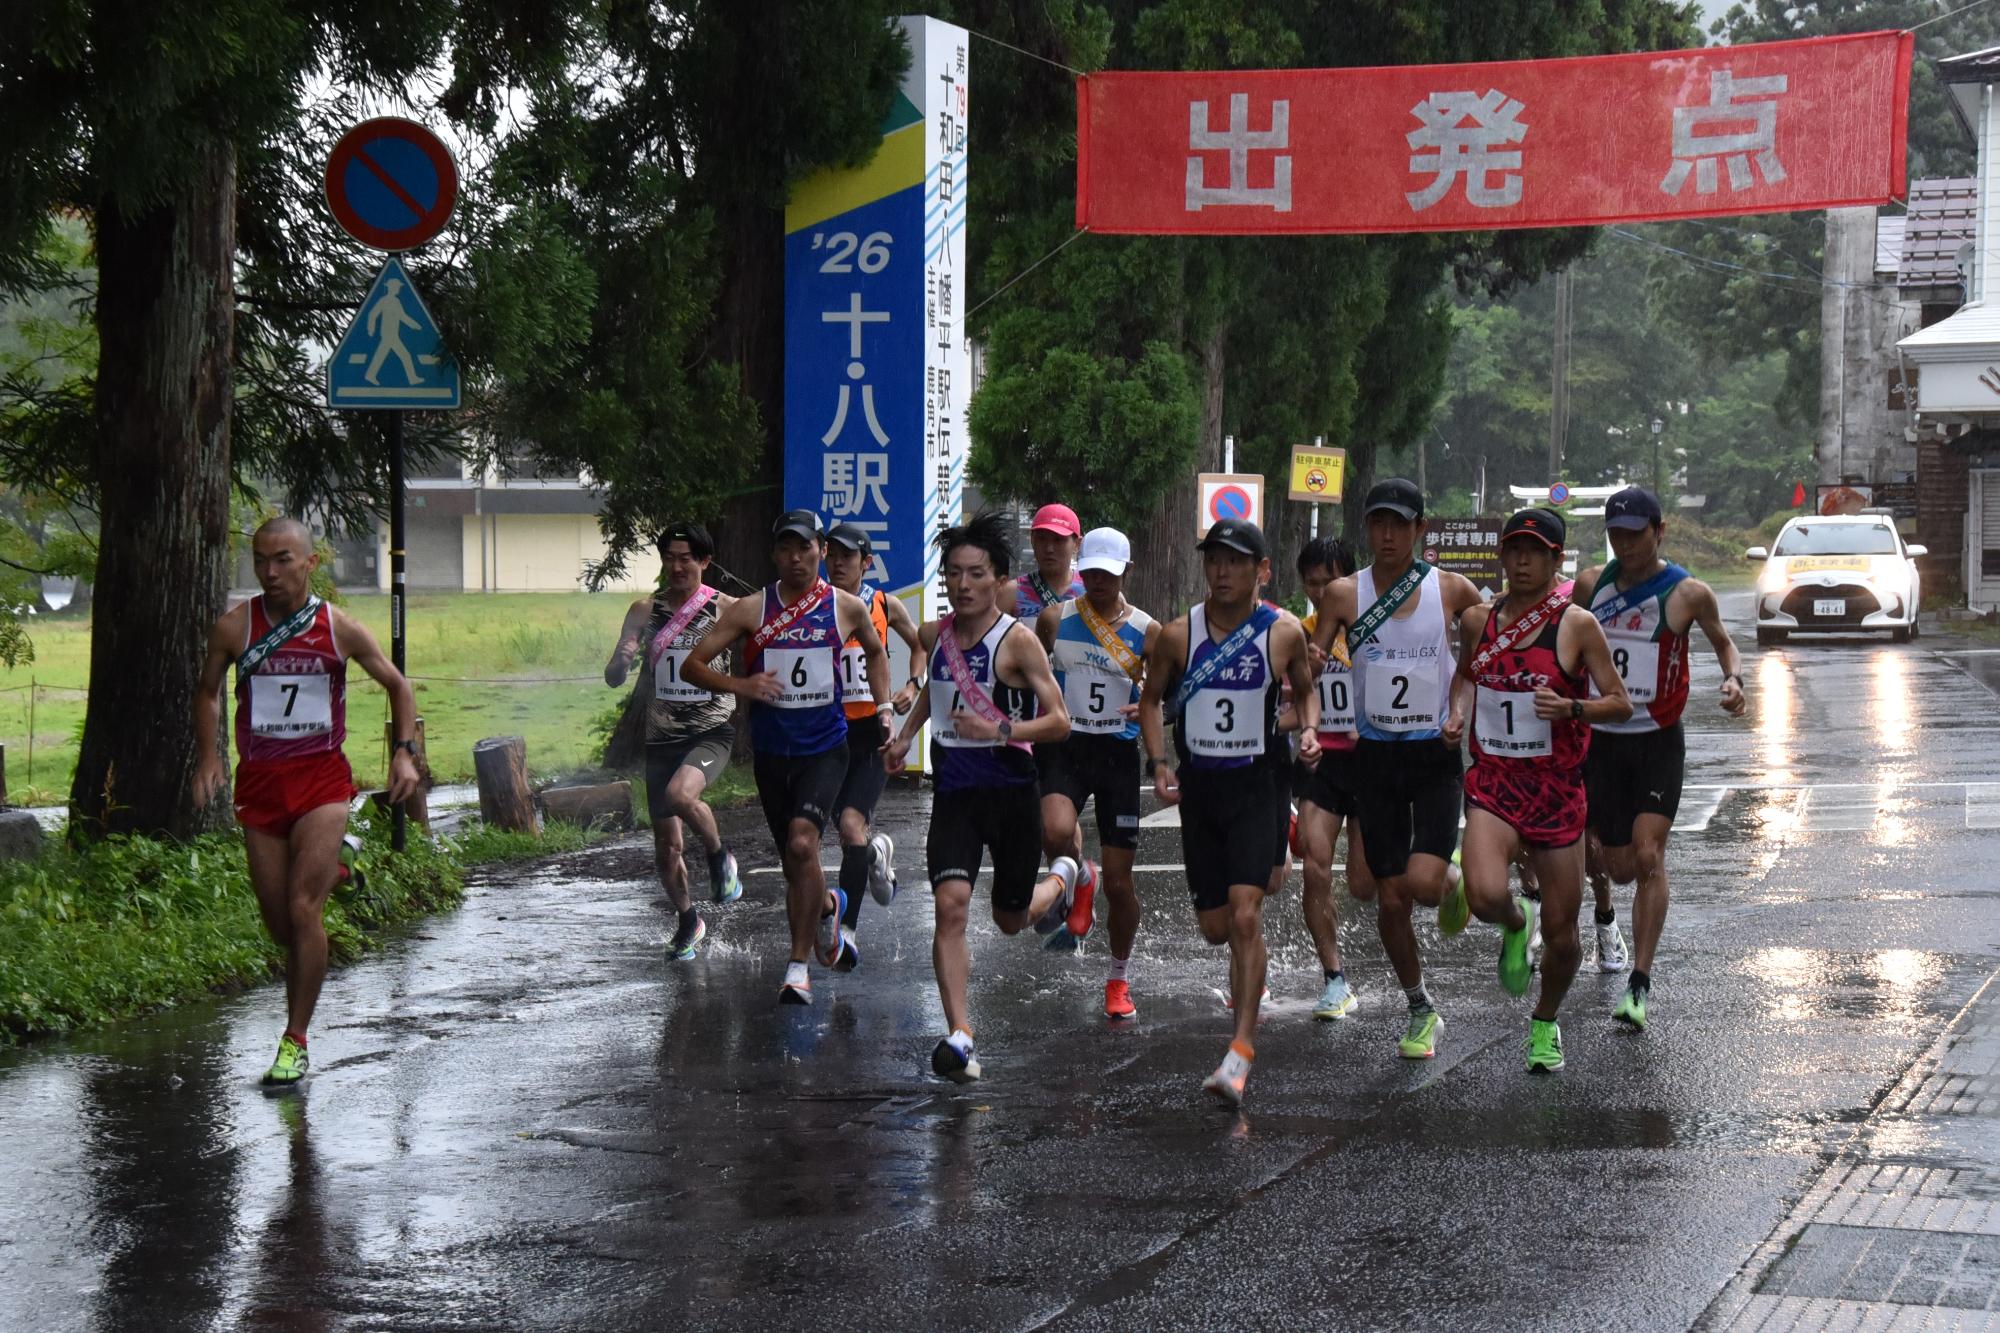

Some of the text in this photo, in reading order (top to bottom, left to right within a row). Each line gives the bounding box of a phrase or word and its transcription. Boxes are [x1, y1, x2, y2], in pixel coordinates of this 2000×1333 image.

[955, 45, 965, 153] 第79回
[1185, 70, 1788, 212] 出発点
[811, 231, 893, 274] '26
[1425, 532, 1498, 547] 歩行者専用
[1445, 522, 1478, 530] ここからは
[257, 657, 325, 673] AKITA
[1084, 651, 1109, 667] YKK
[1386, 646, 1438, 660] 富士山GX
[1612, 648, 1629, 680] 8
[790, 656, 807, 688] 6
[280, 683, 299, 717] 7
[1088, 682, 1106, 714] 5
[1318, 680, 1349, 712] 10
[1391, 675, 1409, 710] 2
[1215, 697, 1234, 734] 3
[1500, 700, 1514, 735] 1
